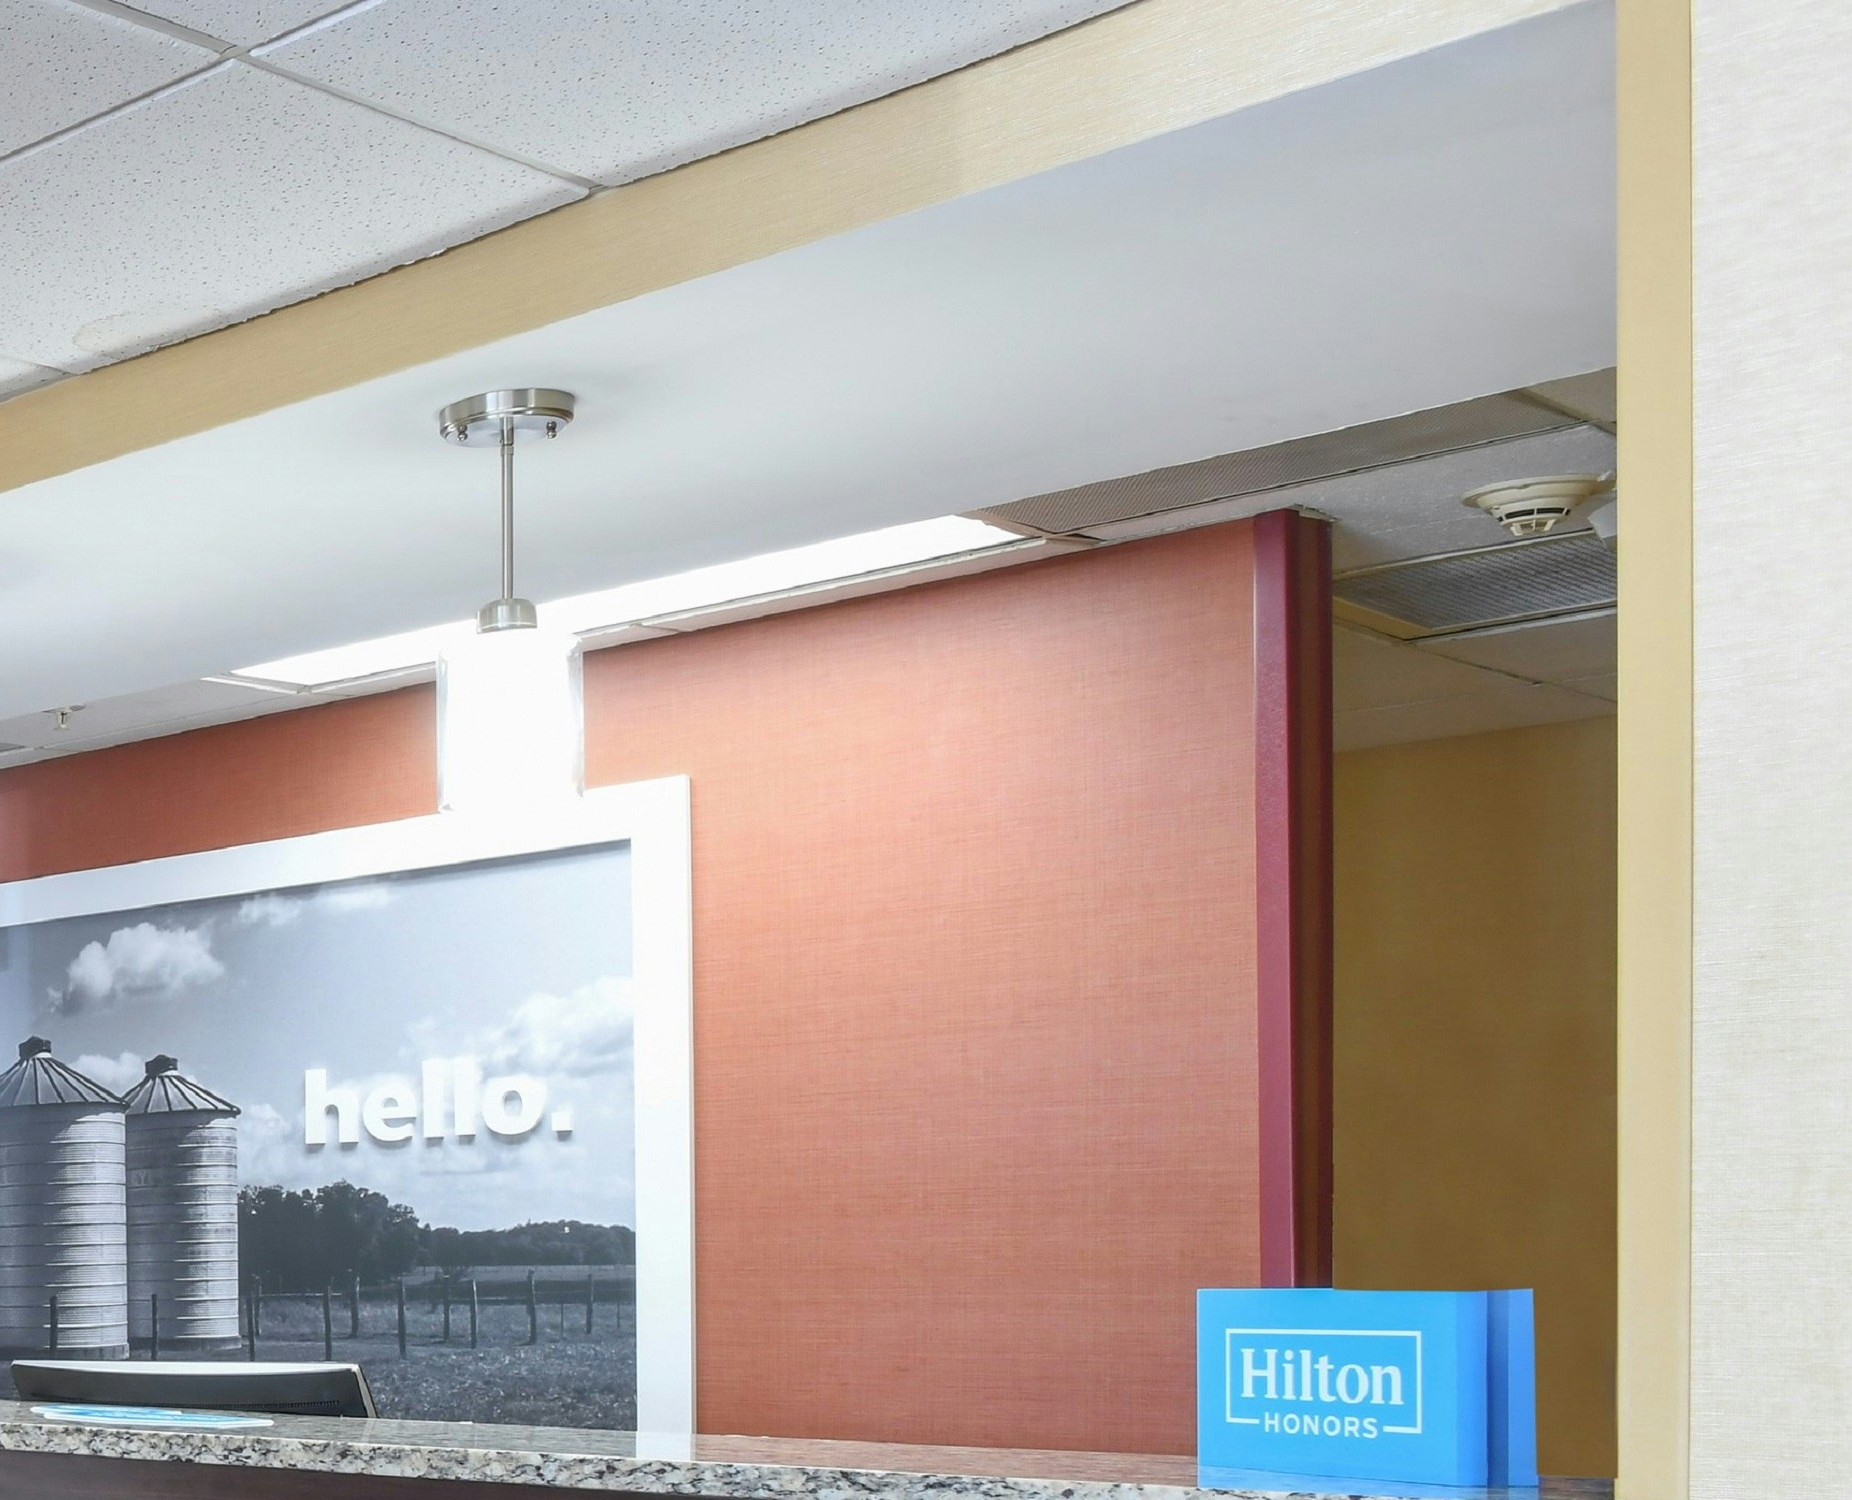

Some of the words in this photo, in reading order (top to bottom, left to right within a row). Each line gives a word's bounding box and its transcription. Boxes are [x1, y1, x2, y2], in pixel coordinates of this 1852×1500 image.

[304, 1055, 574, 1145] hello.
[1240, 1348, 1405, 1406] Hilton
[1264, 1411, 1378, 1440] HONORS
